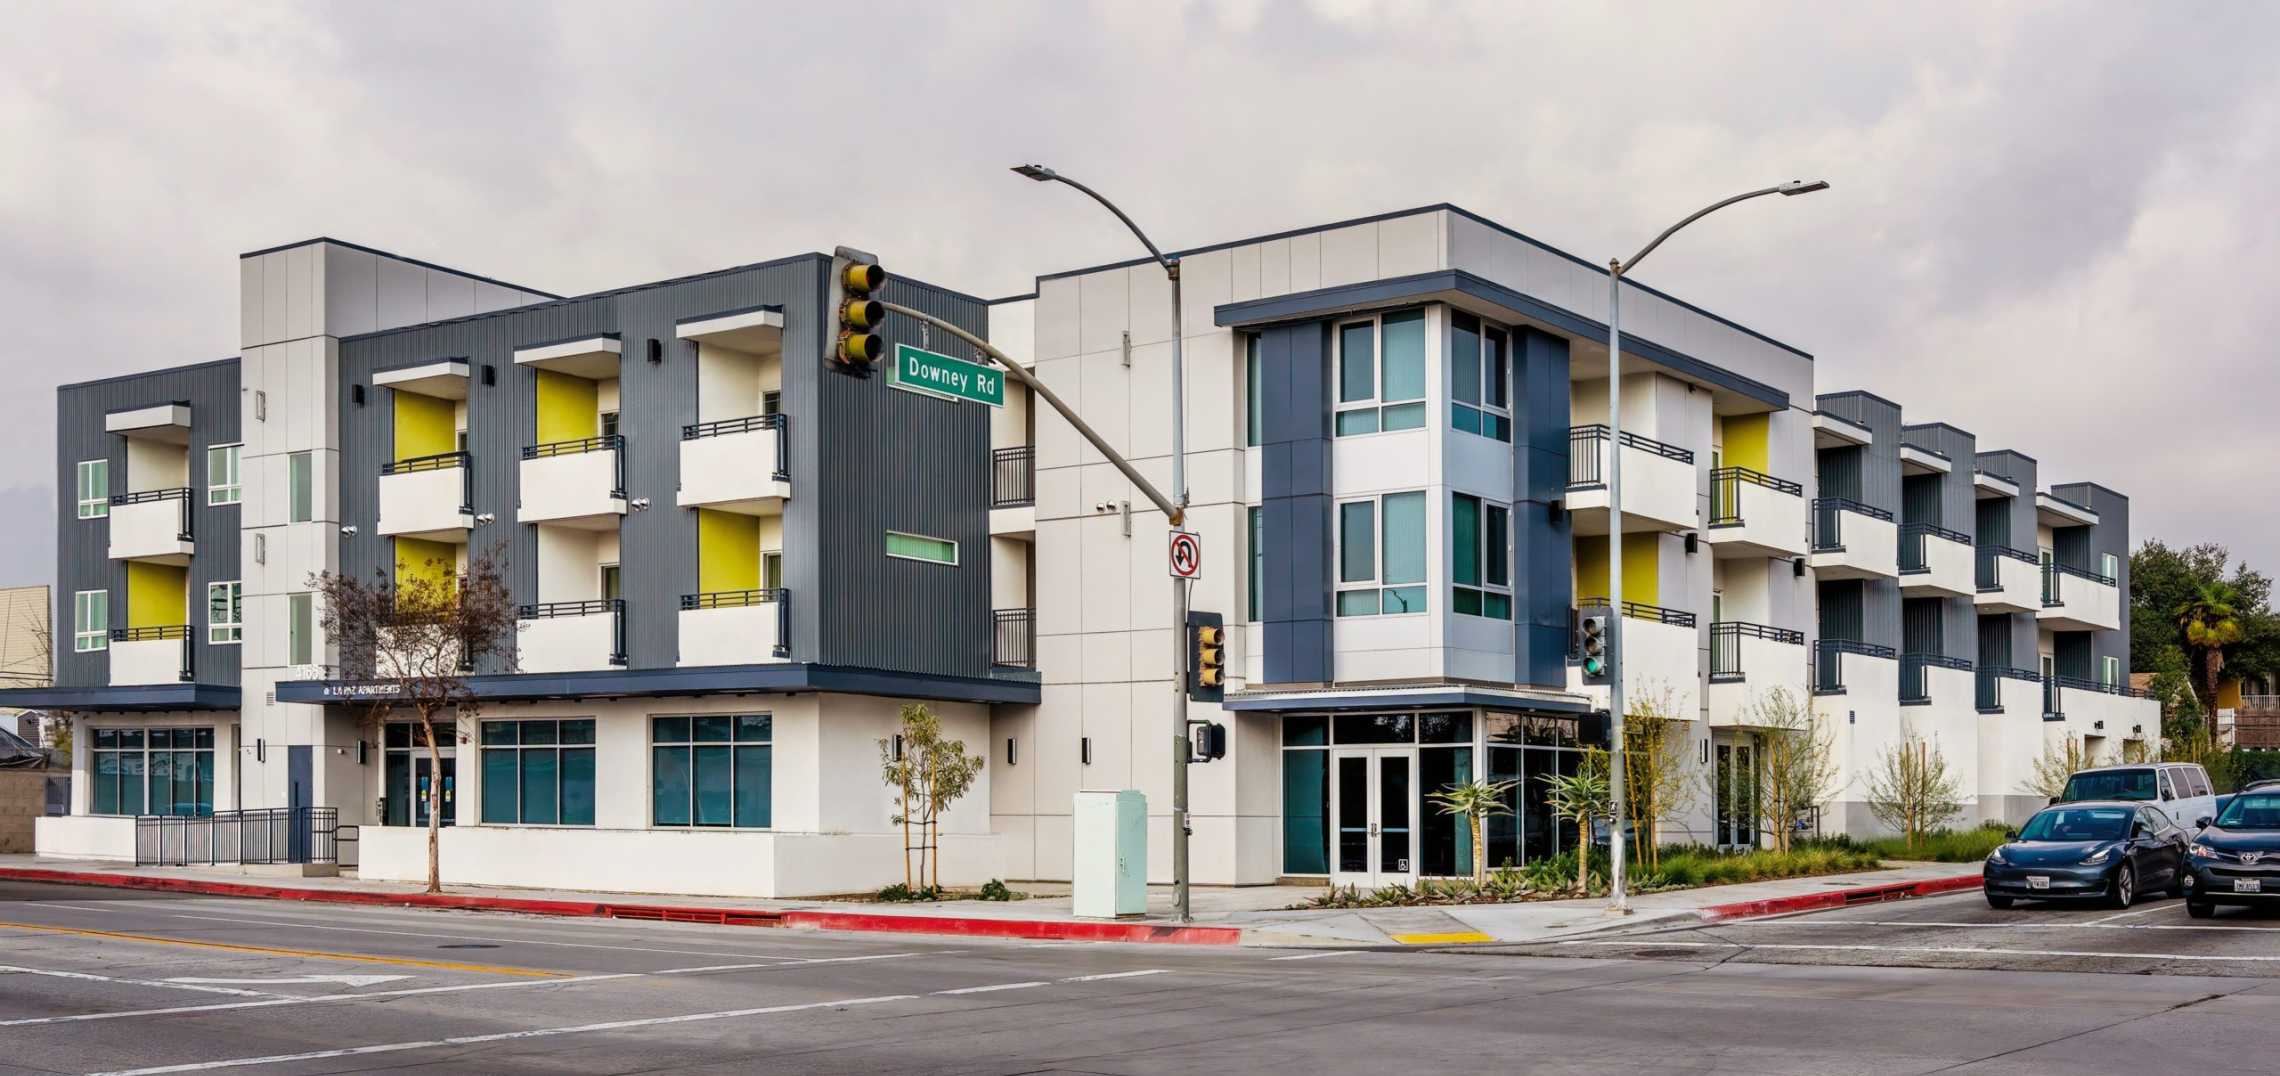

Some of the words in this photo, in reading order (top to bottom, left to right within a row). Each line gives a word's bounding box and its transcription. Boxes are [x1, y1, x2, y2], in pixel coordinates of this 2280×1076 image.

[909, 356, 968, 393] Downey
[977, 373, 995, 395] Rd
[333, 686, 342, 696] LA
[358, 684, 401, 695] APARTMENTS
